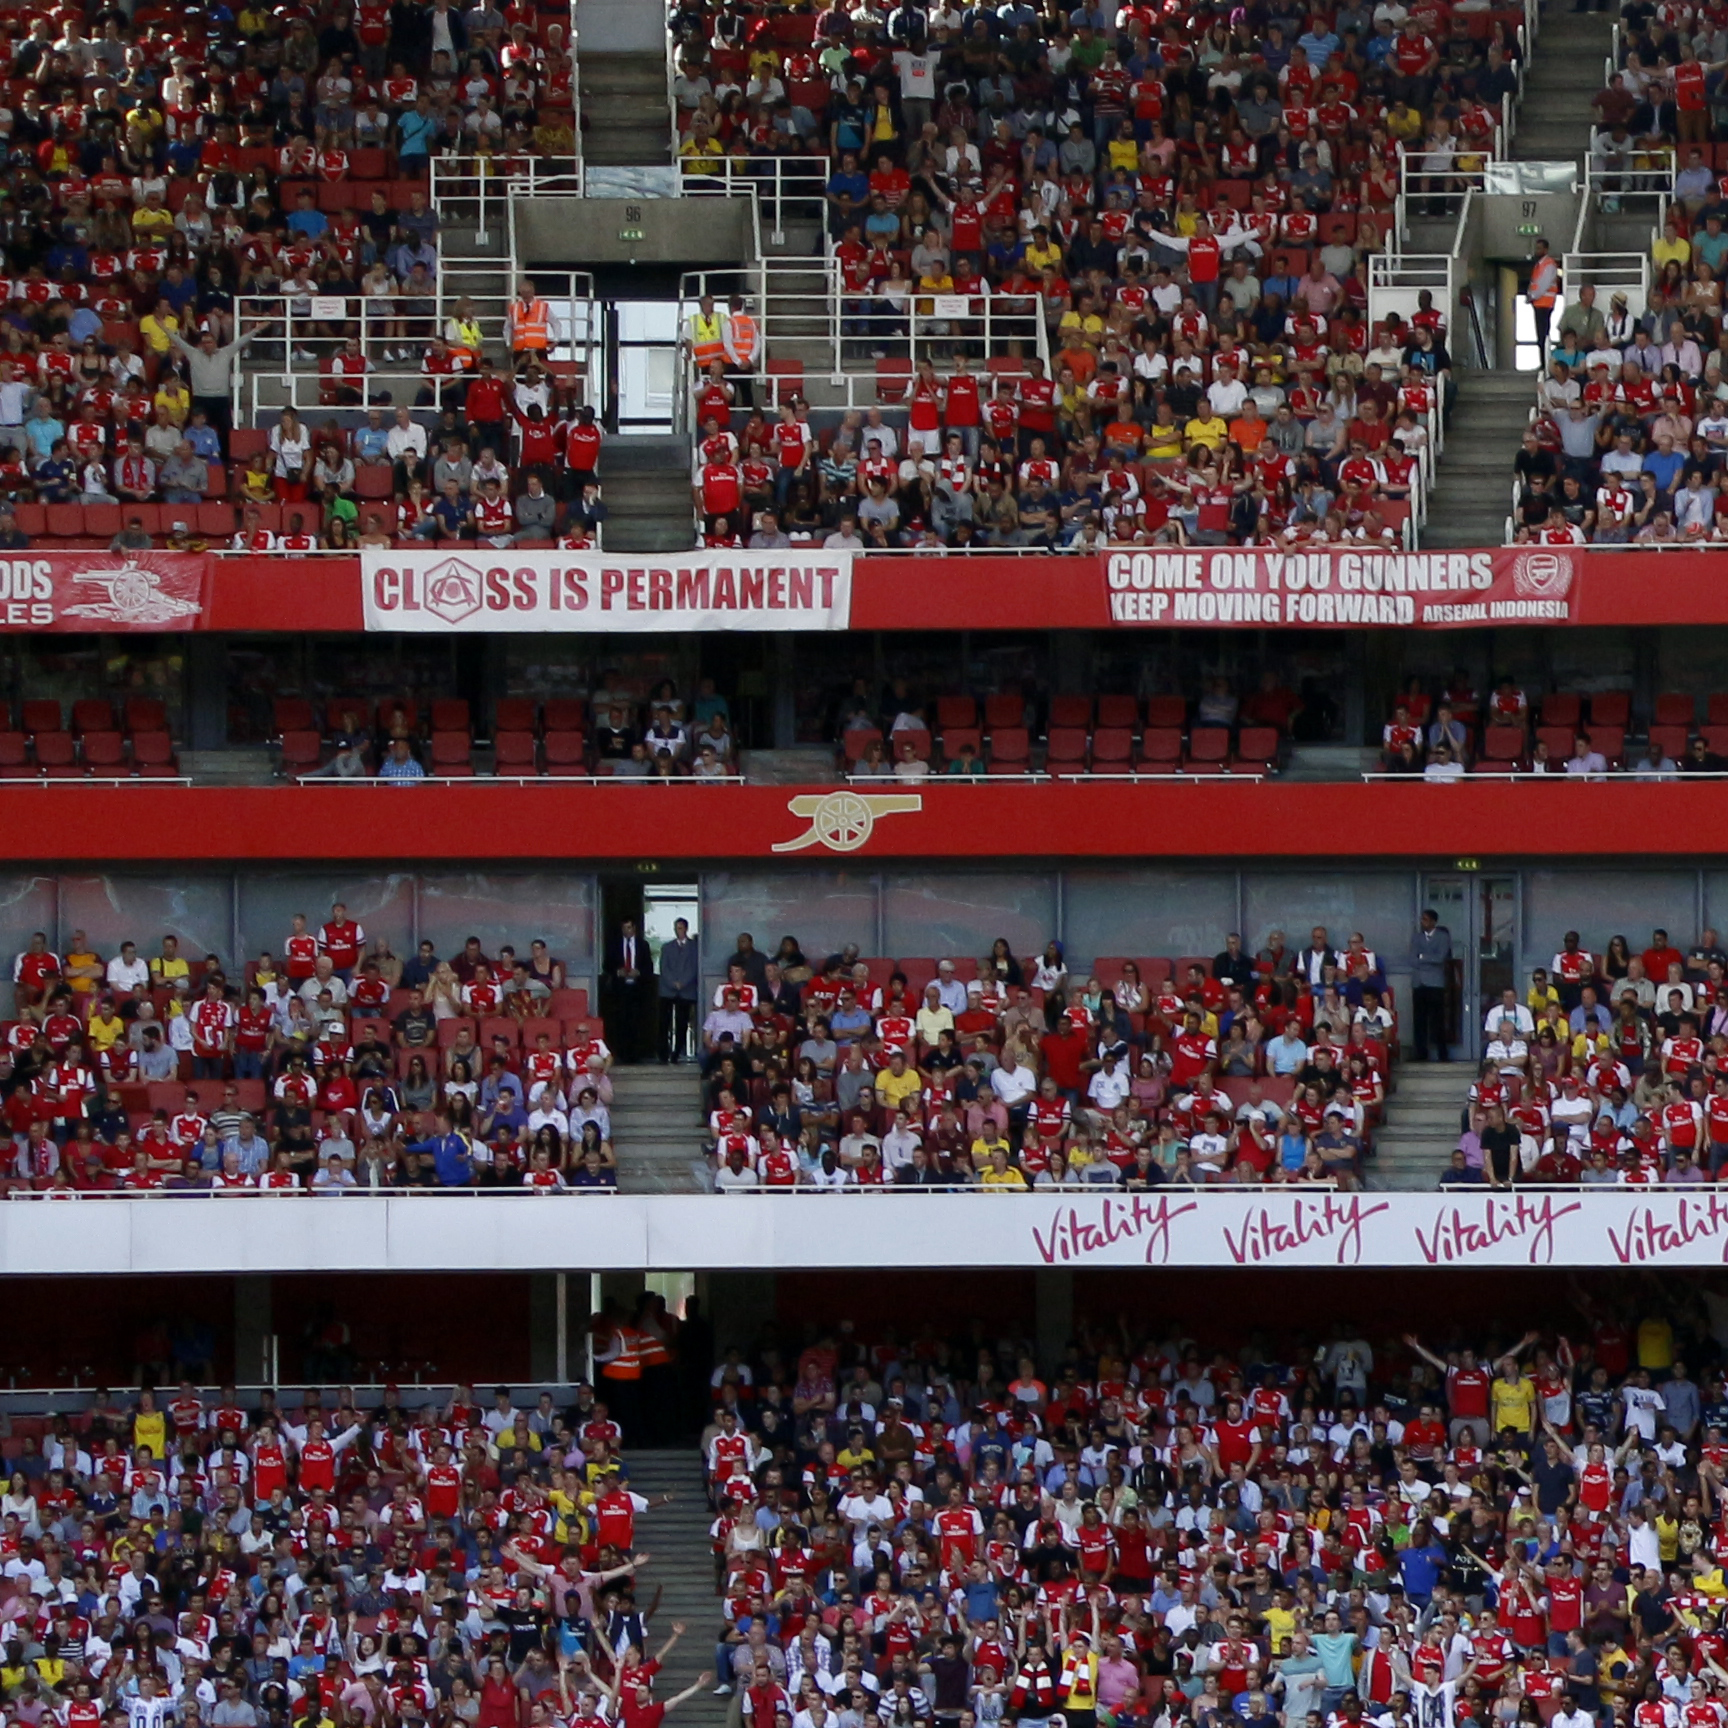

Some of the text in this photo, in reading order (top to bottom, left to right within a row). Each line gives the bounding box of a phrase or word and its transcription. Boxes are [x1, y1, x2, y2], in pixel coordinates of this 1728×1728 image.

[625, 206, 641, 222] 96
[1522, 201, 1537, 218] 97
[1107, 551, 1495, 591] COME ON YOU GUNNERS
[549, 567, 588, 611] IS
[600, 566, 840, 611] PERMANENT
[0, 603, 54, 624] ES
[1110, 591, 1569, 624] KEEP MOVING FORWARD ARSENAL INDONESIA
[1032, 1194, 1198, 1264] Vitality
[1223, 1194, 1390, 1264] Vitality
[1415, 1194, 1582, 1264] Vitality
